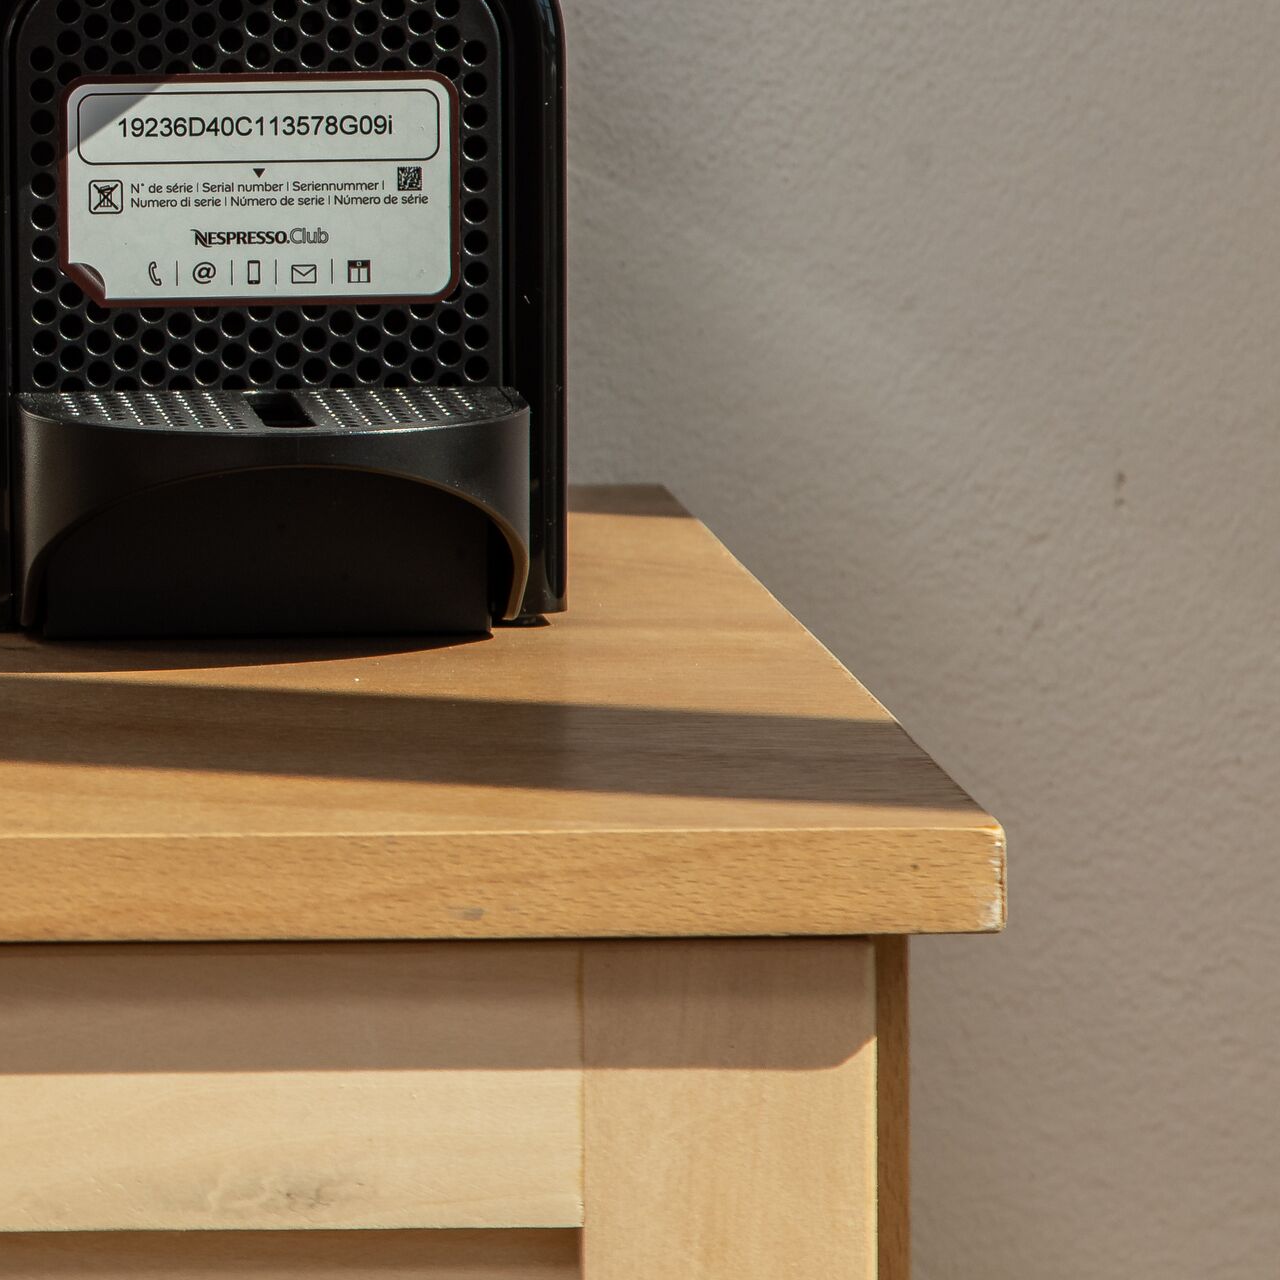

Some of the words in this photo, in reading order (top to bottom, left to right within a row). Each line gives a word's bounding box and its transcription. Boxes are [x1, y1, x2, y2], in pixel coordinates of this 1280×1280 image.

[118, 115, 393, 137] 19236D40C113578G09i
[148, 183, 163, 194] de
[165, 182, 194, 194] série
[202, 181, 235, 193] Serial
[237, 181, 284, 193] number
[292, 180, 380, 192] Seriennummer
[130, 197, 178, 209] Numero
[180, 196, 191, 208] di
[193, 196, 222, 208] serie
[230, 195, 278, 207] Número
[279, 195, 295, 207] de
[297, 194, 325, 206] serie
[333, 194, 381, 206] Número
[383, 193, 399, 205] de
[401, 193, 429, 205] série
